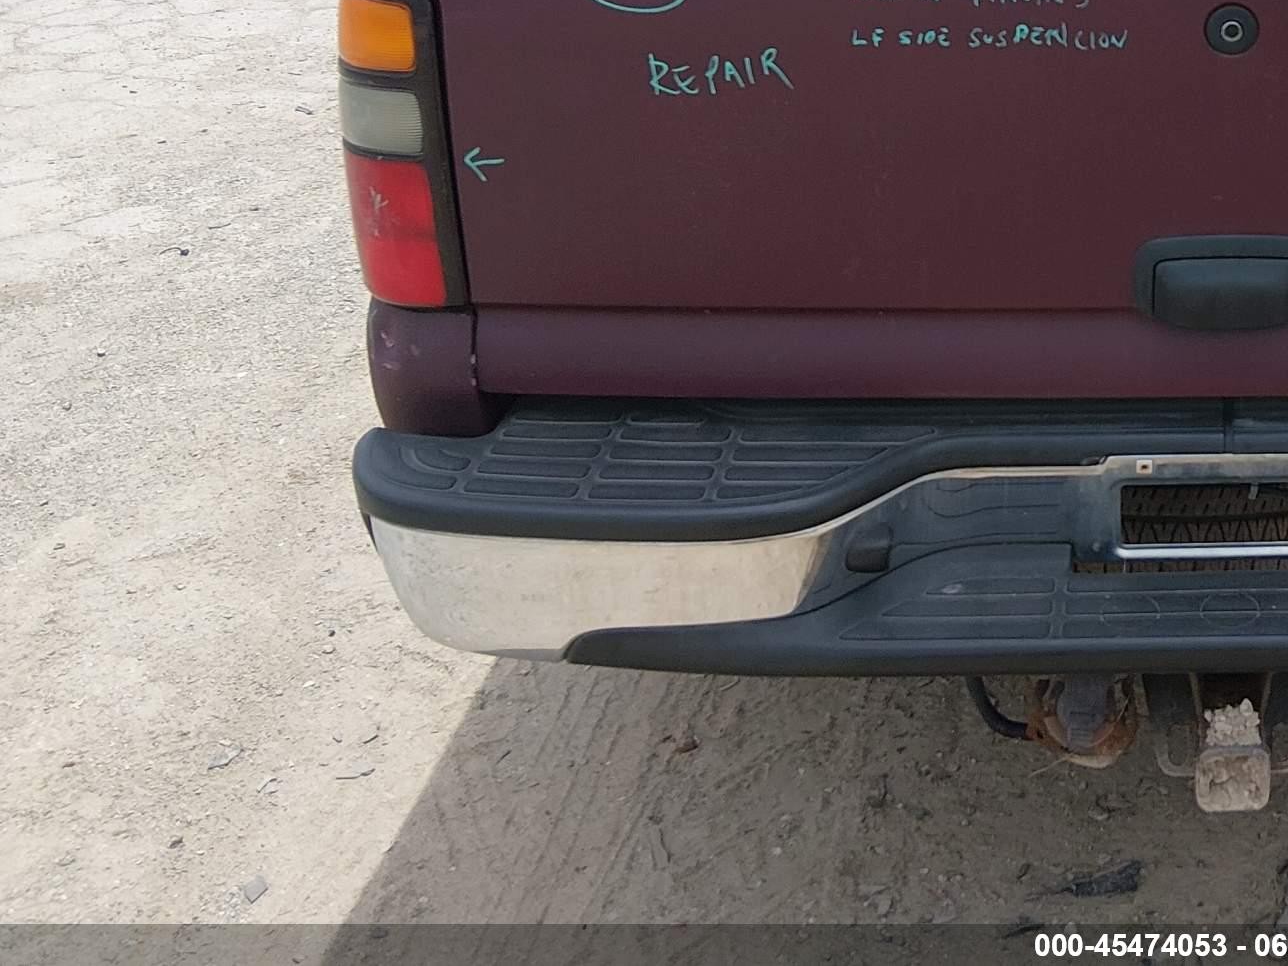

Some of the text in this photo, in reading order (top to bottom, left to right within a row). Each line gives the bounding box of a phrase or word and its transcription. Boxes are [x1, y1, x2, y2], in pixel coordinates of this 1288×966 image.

[851, 22, 1129, 51] LF SIDE SUSPENCION
[648, 47, 795, 96] REPAIR
